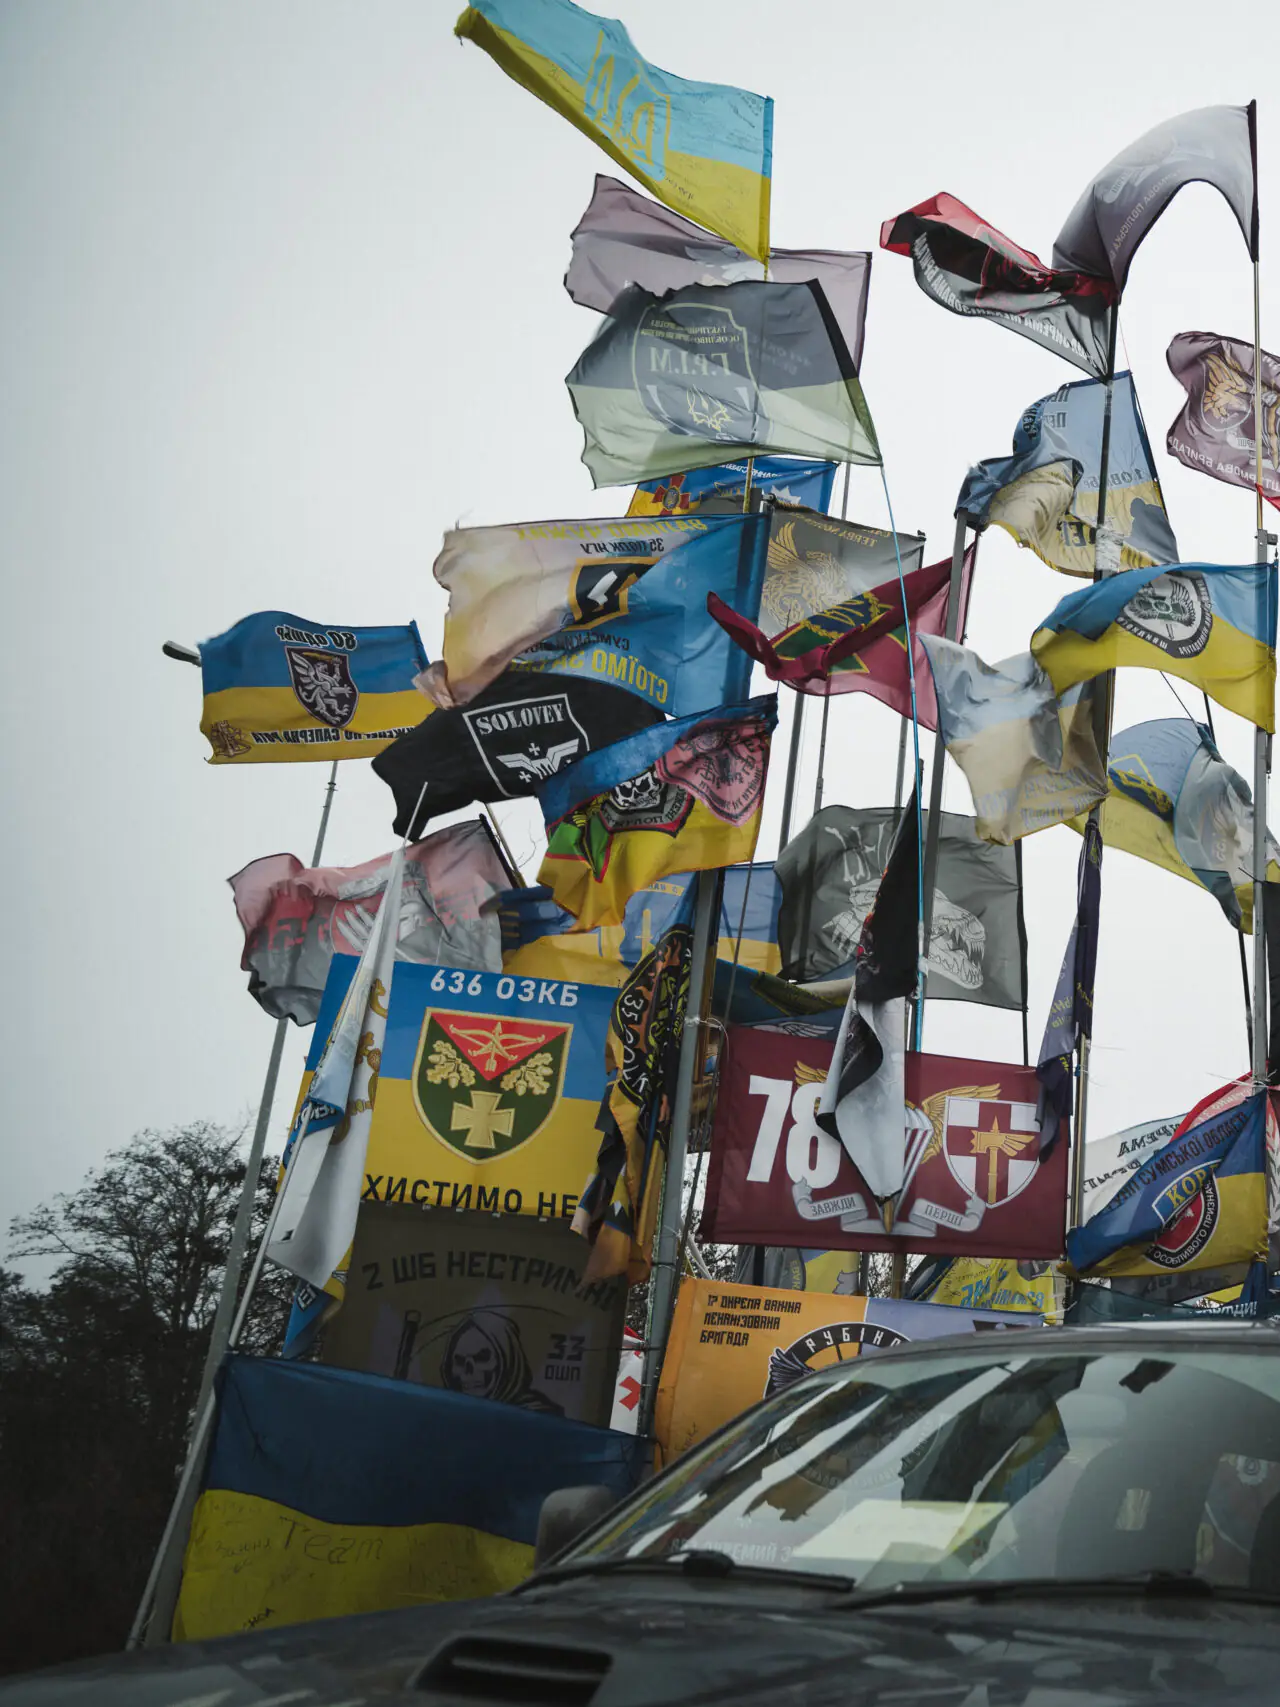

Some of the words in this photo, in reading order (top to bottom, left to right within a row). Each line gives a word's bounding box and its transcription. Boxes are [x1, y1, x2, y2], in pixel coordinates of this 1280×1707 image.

[475, 703, 567, 736] SOLOVEY
[429, 969, 483, 997] 636
[495, 976, 580, 1007] ОЗКБ
[622, 992, 645, 1023] 35
[746, 1074, 842, 1191] 78
[360, 1173, 523, 1216] ХИСТИМО
[536, 1190, 580, 1218] НЕ
[809, 1196, 857, 1218] ЗАВЖДИ
[923, 1203, 964, 1227] ПЕРШІ
[1153, 1229, 1208, 1265] ОСОБЛИВОГО
[361, 1261, 385, 1292] 2
[391, 1251, 437, 1285] ШБ
[546, 1332, 586, 1362] 33
[699, 1329, 750, 1347] БРИГАДА
[544, 1363, 581, 1381] ОШП
